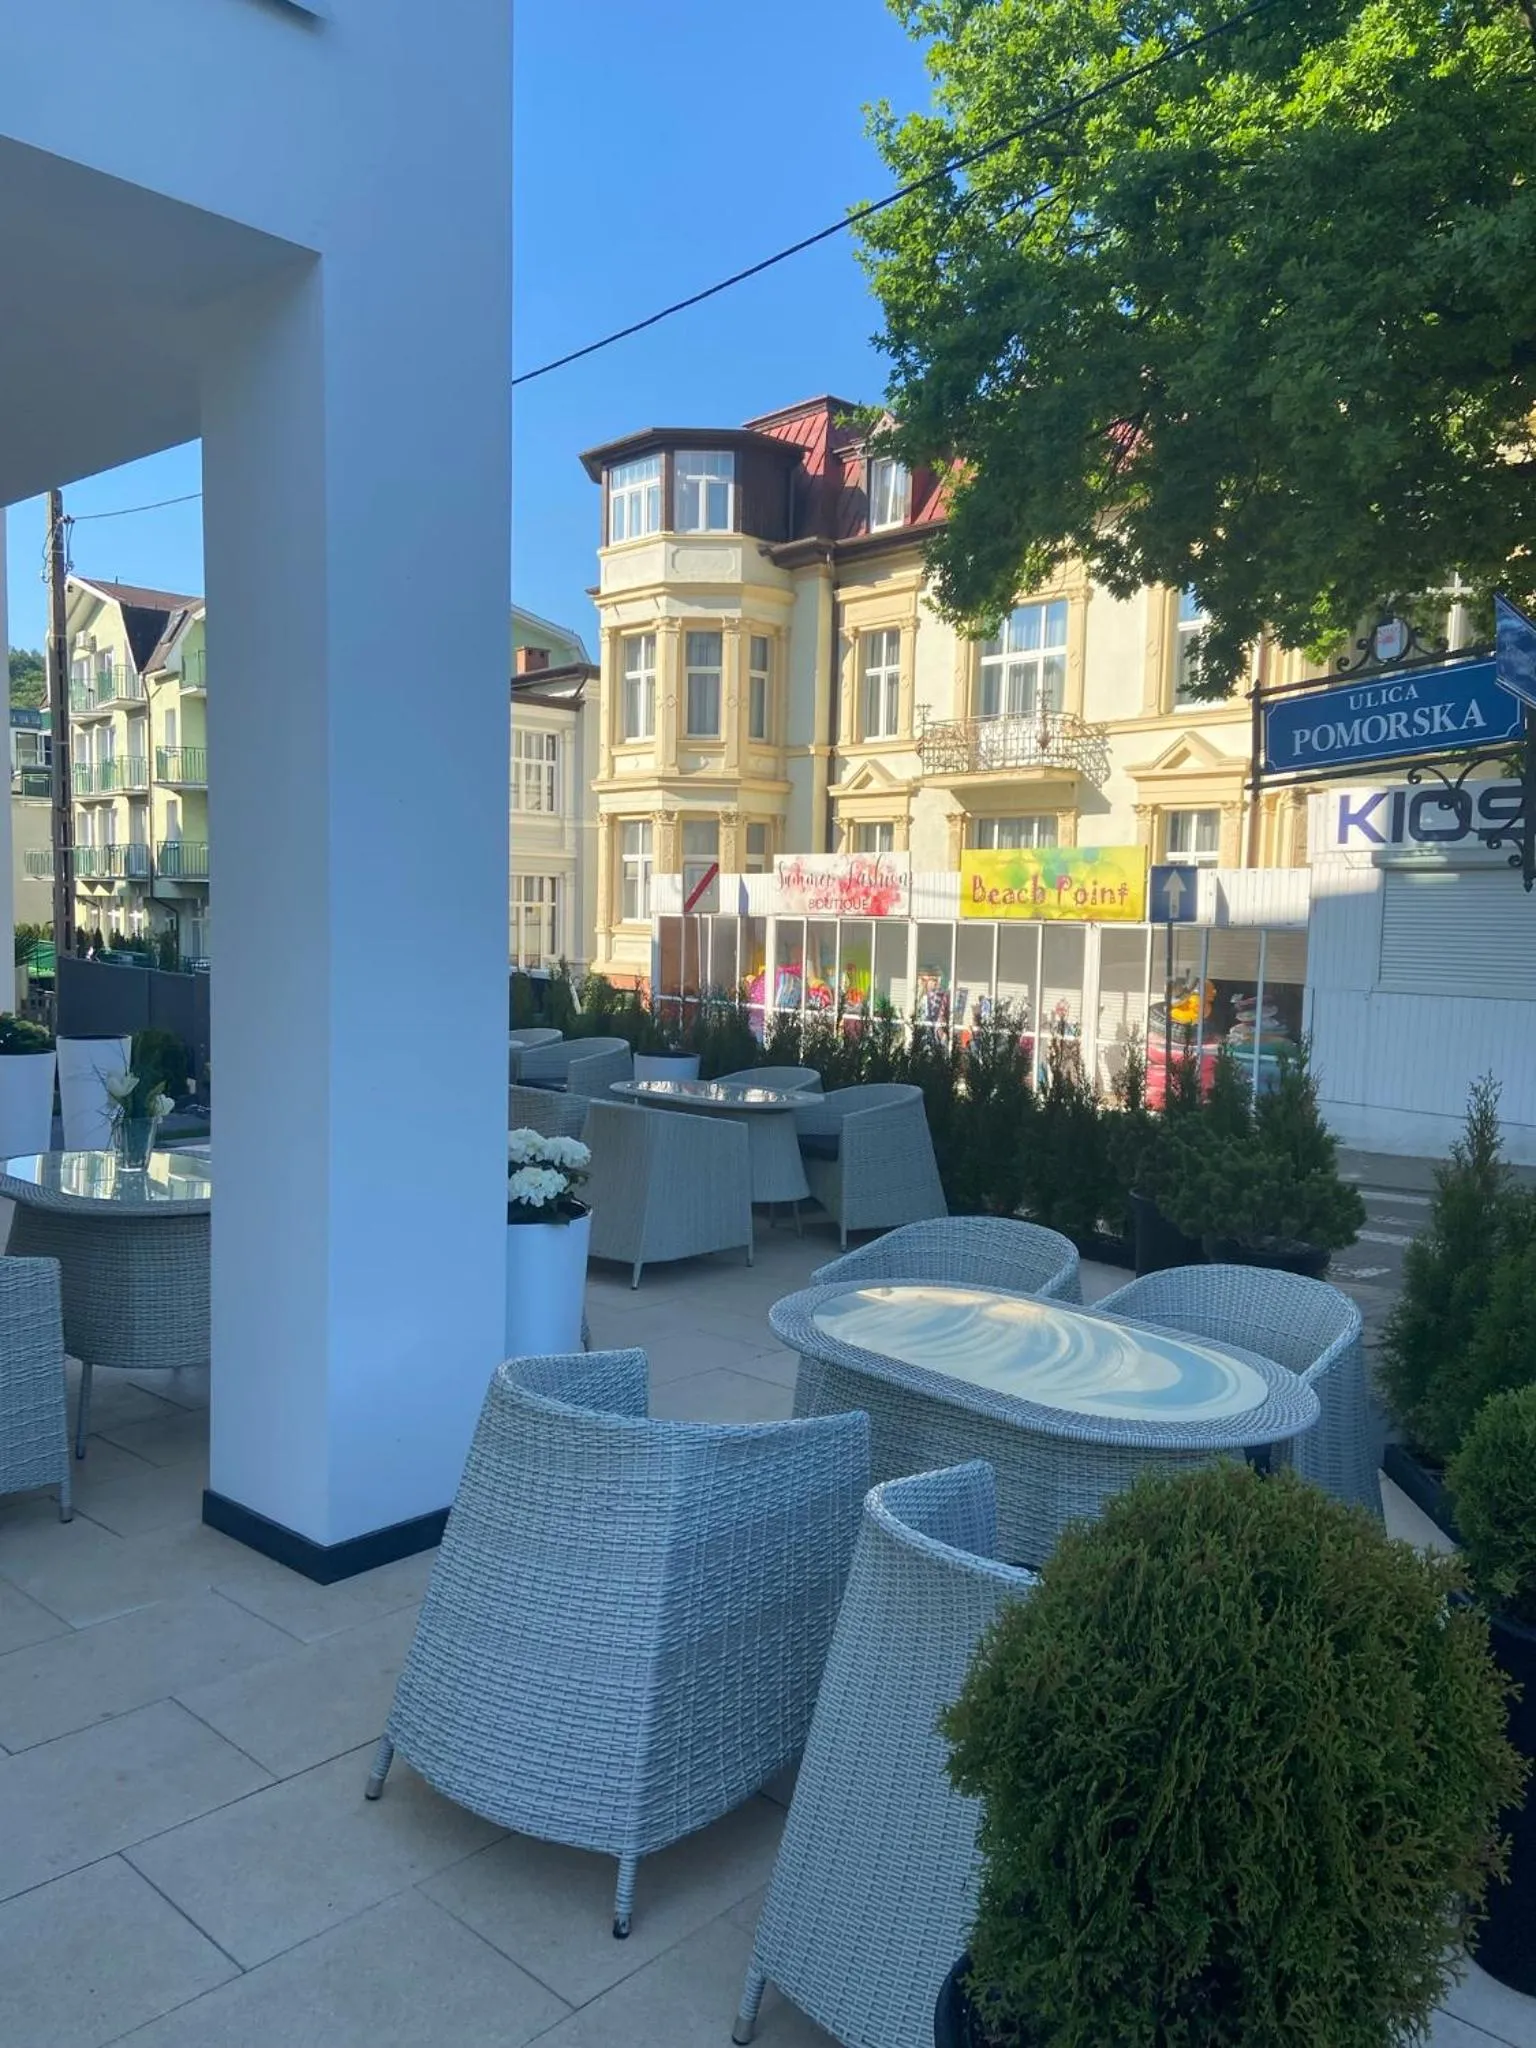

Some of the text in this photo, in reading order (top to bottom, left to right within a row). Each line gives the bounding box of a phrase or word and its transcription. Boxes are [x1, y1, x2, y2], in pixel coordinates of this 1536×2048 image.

[1349, 684, 1419, 711] ULICA
[1292, 699, 1487, 756] POMORSKA
[778, 854, 908, 893] Summer Fashion
[972, 873, 1129, 906] Beach Point
[808, 898, 869, 911] BOUTIQUE
